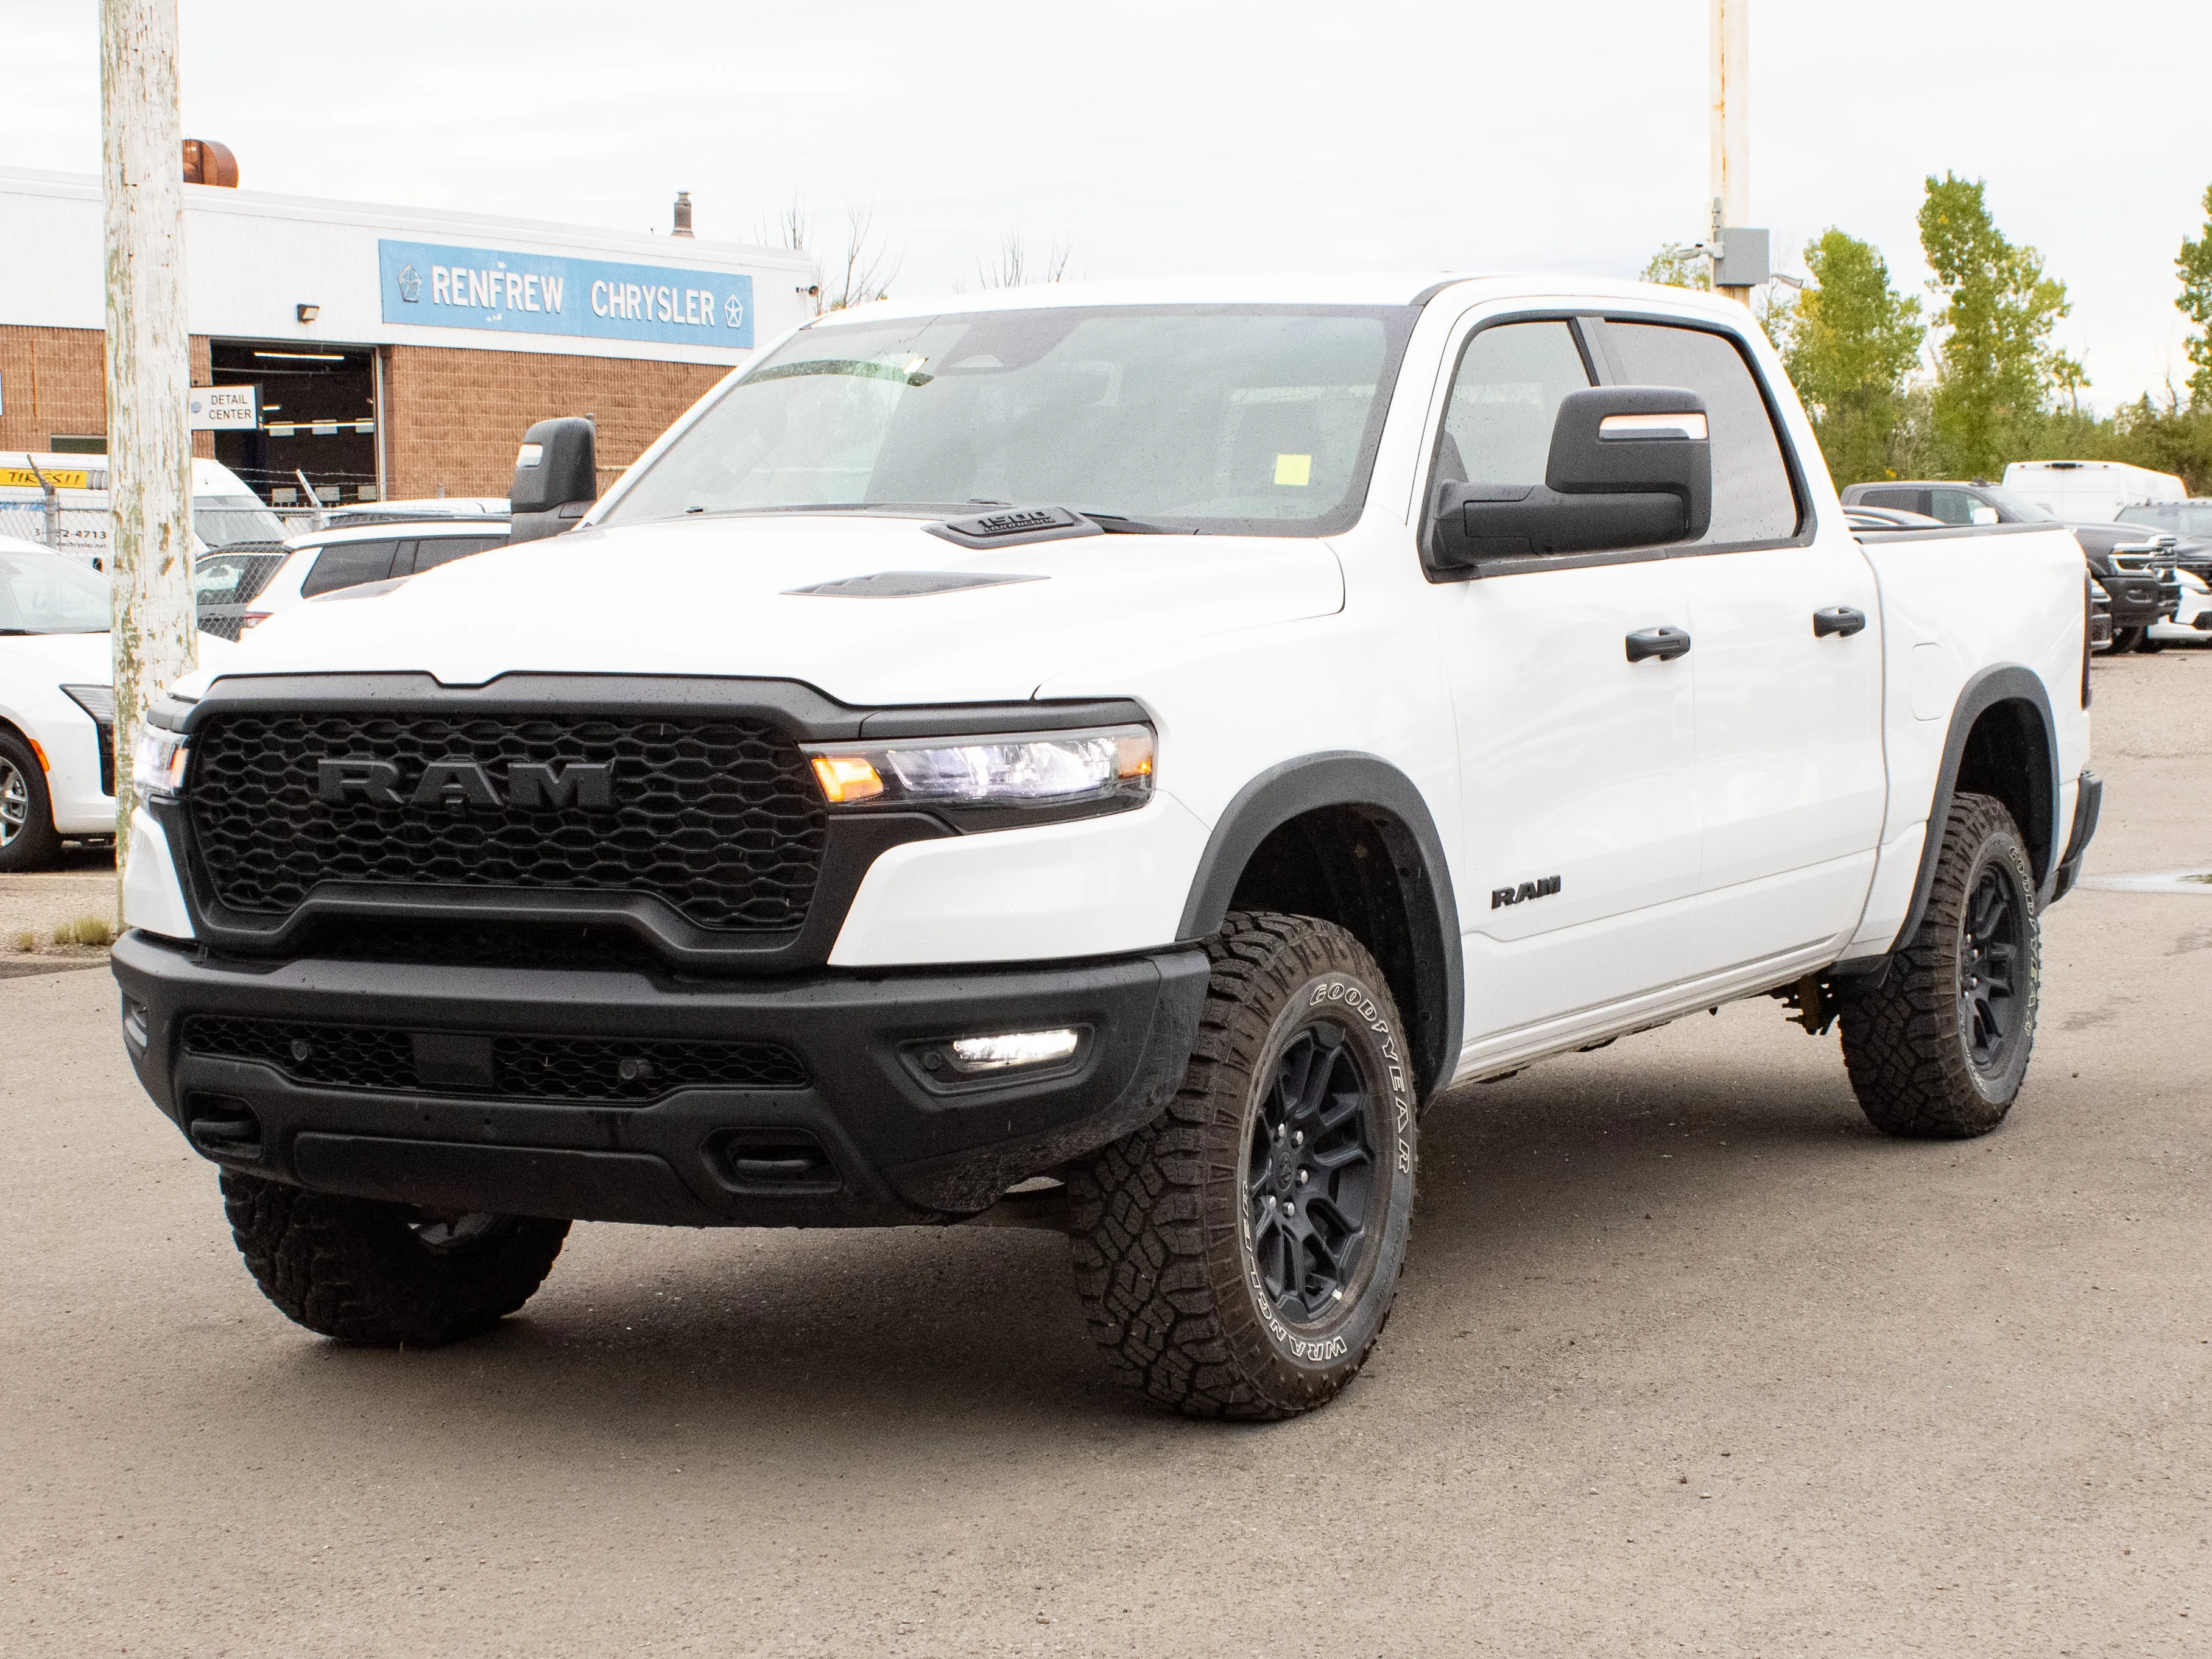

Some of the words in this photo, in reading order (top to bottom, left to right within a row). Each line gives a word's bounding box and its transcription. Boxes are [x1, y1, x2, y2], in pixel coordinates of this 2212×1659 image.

[431, 265, 563, 313] RENFREW
[591, 280, 716, 326] CHRYSLER
[209, 409, 252, 420] CENTER
[211, 394, 248, 406] DETAIL
[977, 511, 1051, 529] 1500
[318, 758, 614, 808] RAM
[1491, 874, 1561, 910] RAM
[1309, 982, 1410, 1174] GOODYEAR
[1242, 1180, 1348, 1361] WRANGLER
